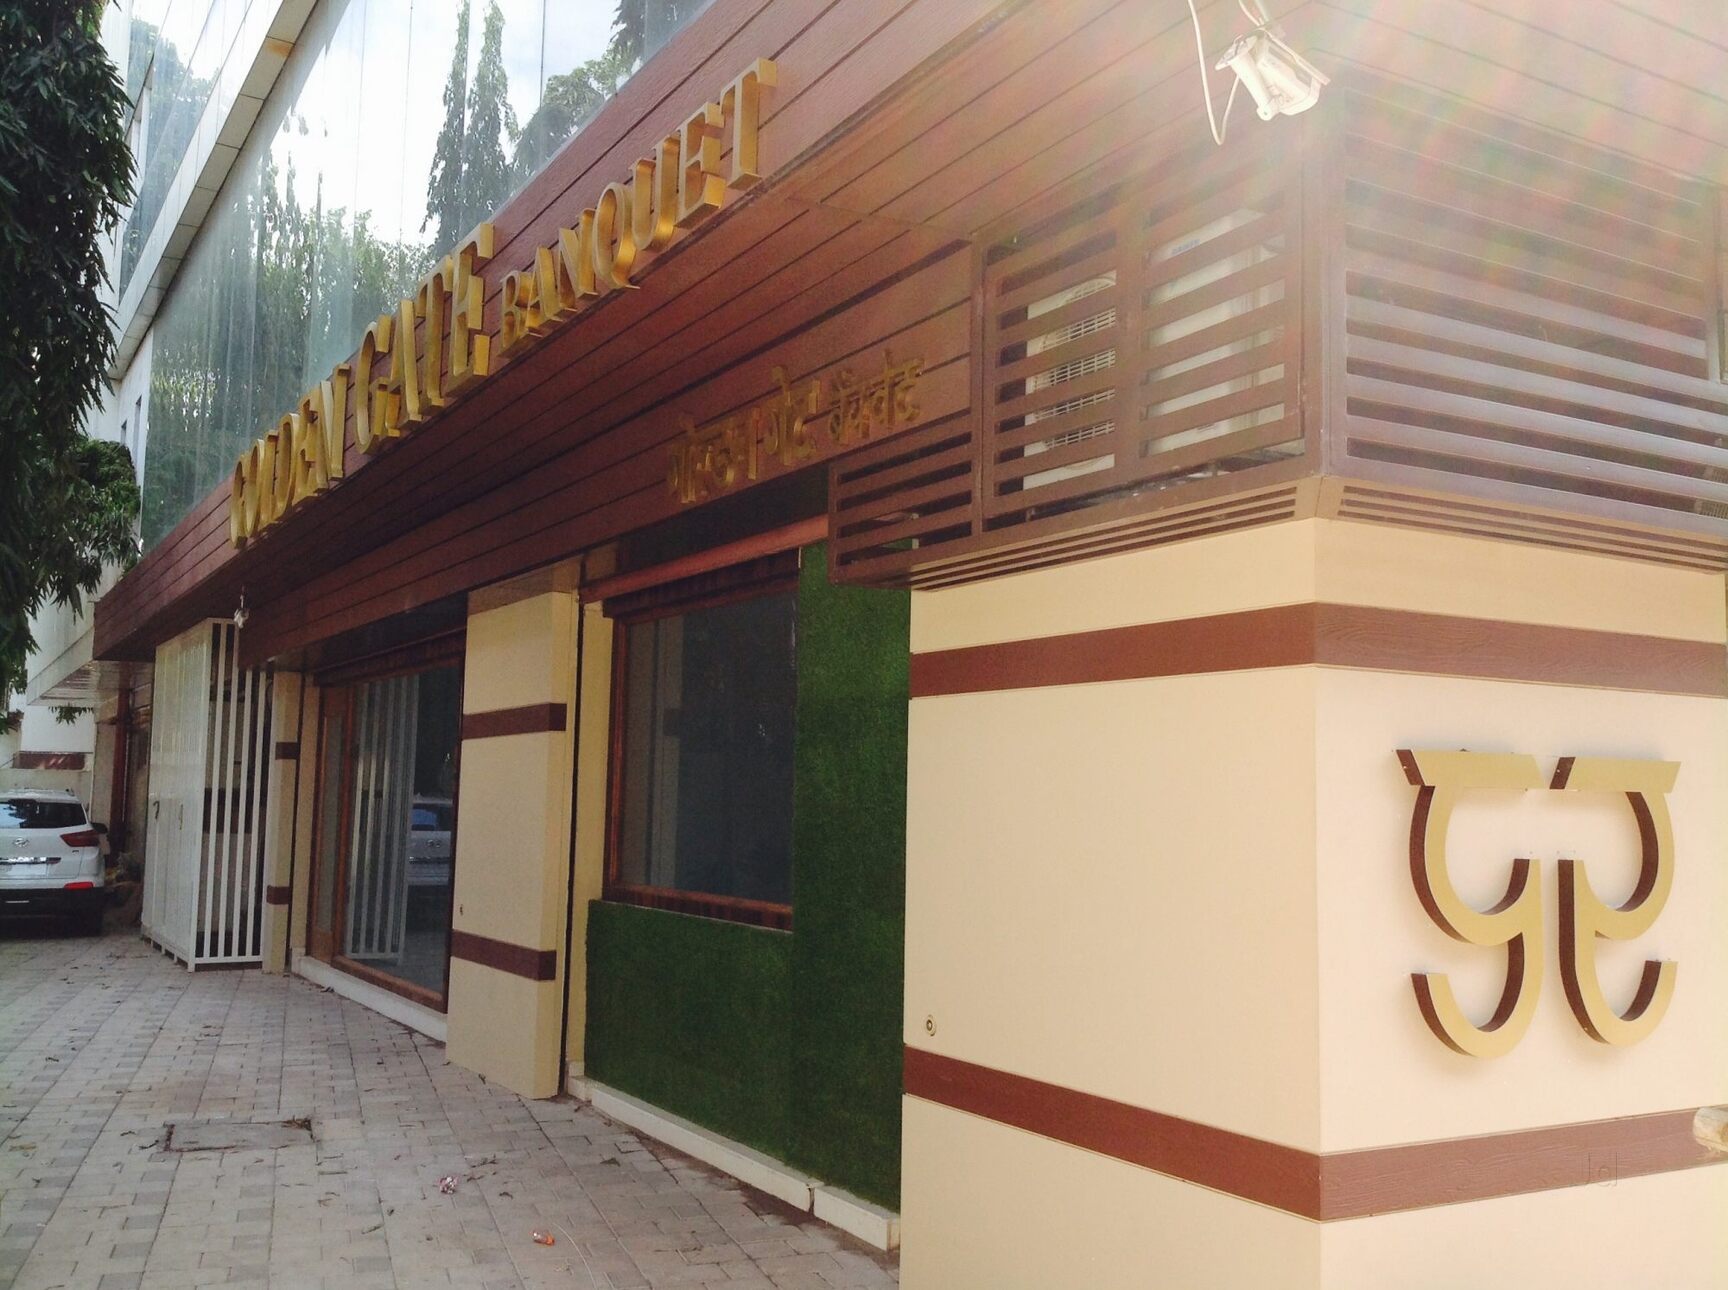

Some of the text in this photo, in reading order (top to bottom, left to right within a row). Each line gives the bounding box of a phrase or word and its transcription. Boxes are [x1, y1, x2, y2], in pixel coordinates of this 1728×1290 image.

[230, 57, 777, 549] GOLDEN GATE BANQUET
